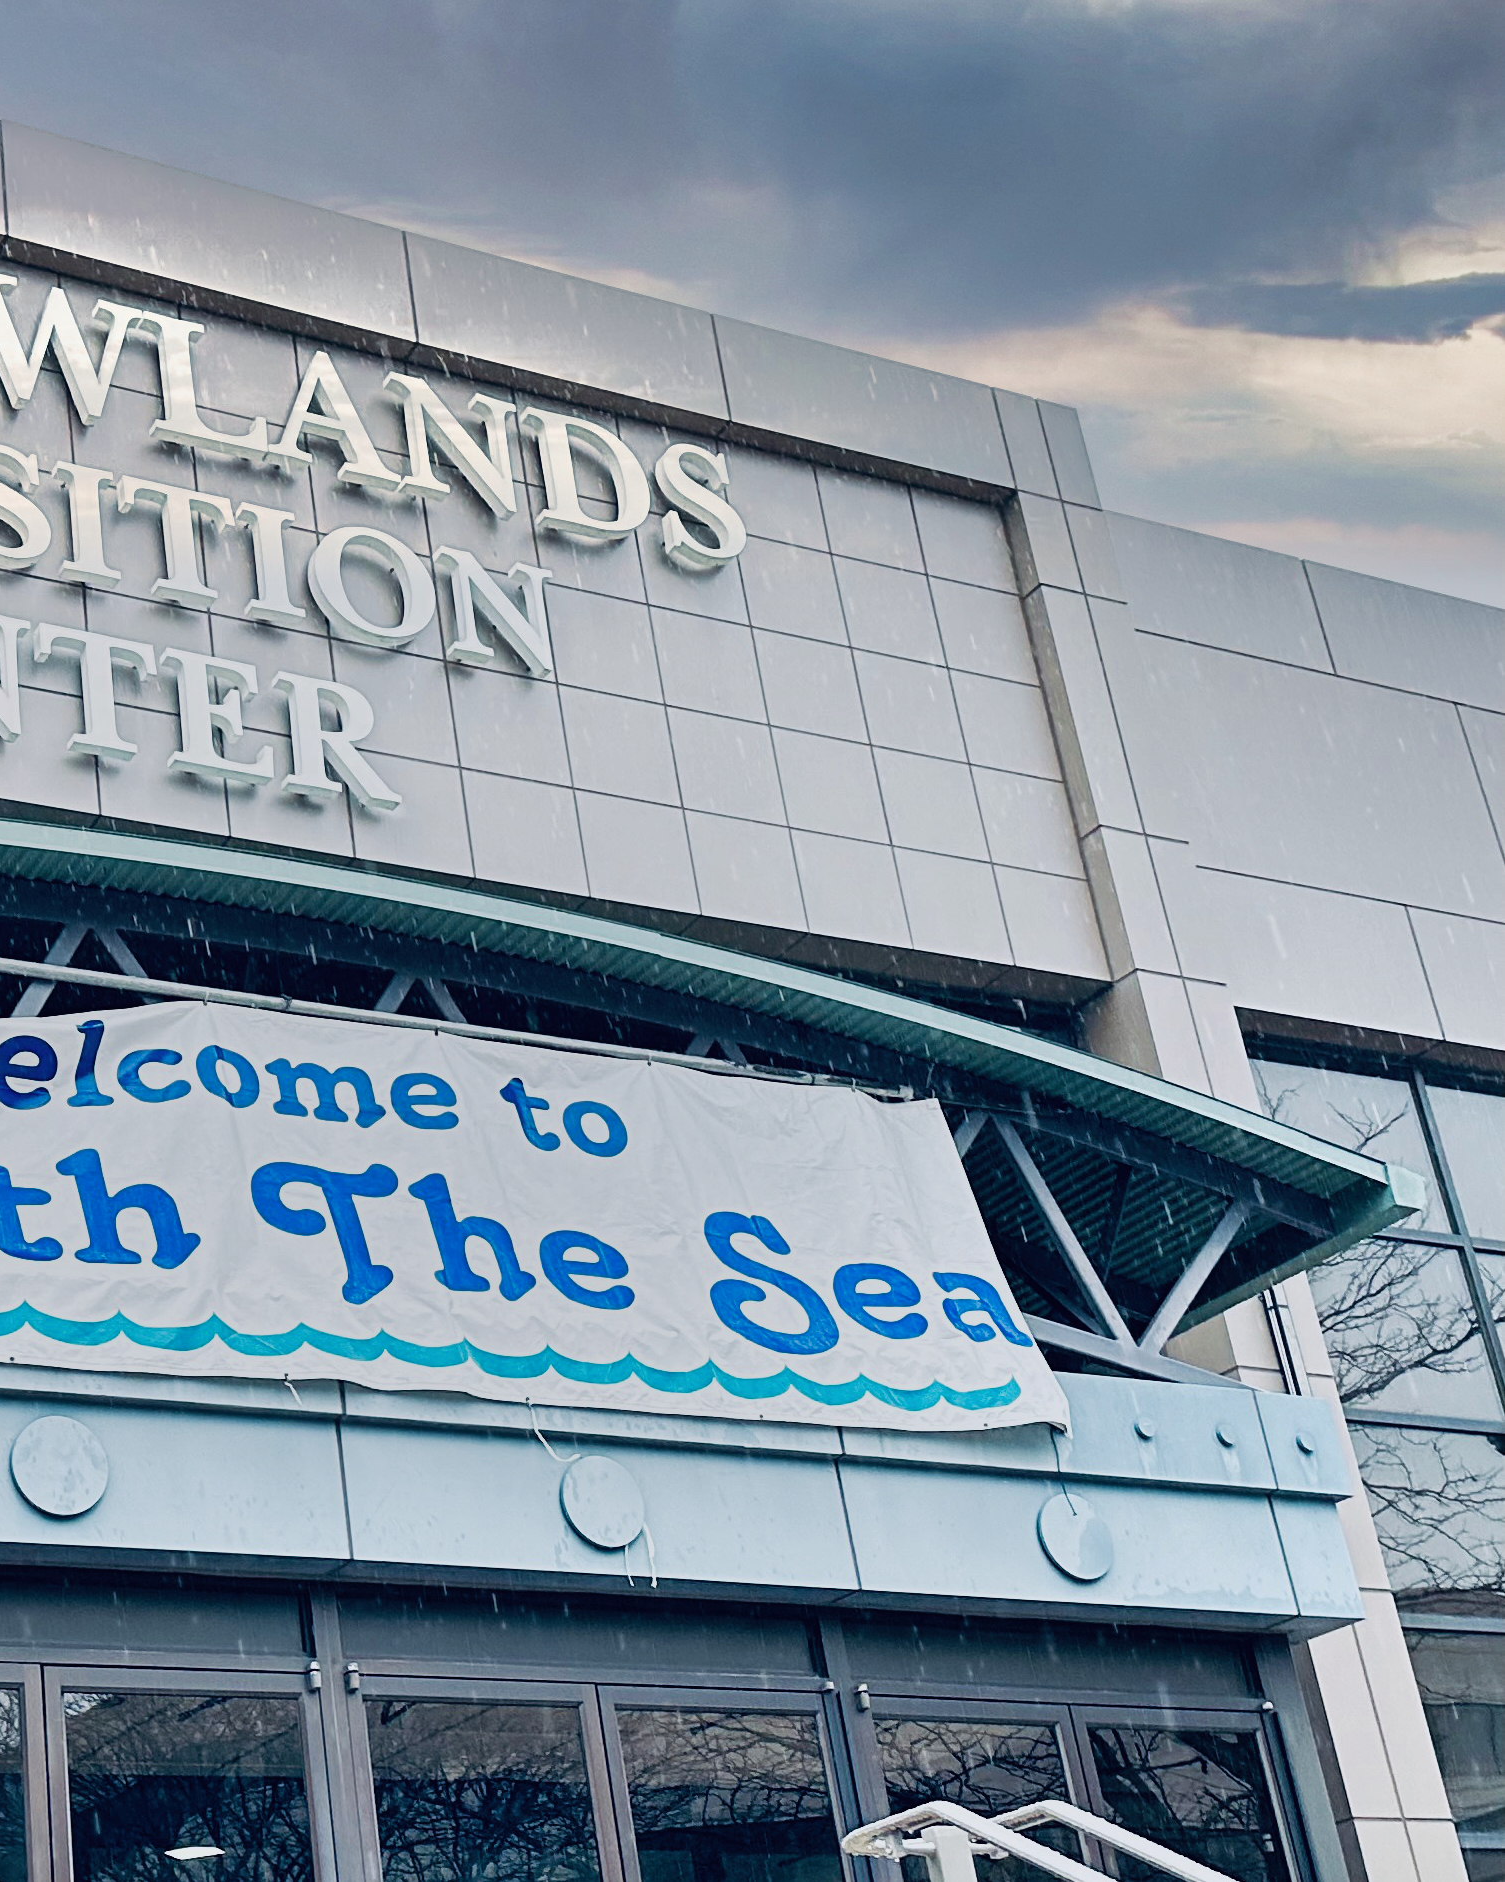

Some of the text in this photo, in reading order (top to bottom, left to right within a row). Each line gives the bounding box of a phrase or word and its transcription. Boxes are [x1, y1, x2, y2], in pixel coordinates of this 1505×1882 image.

[500, 1077, 628, 1157] to
[250, 1161, 635, 1311] The
[703, 1211, 1033, 1355] Sea
